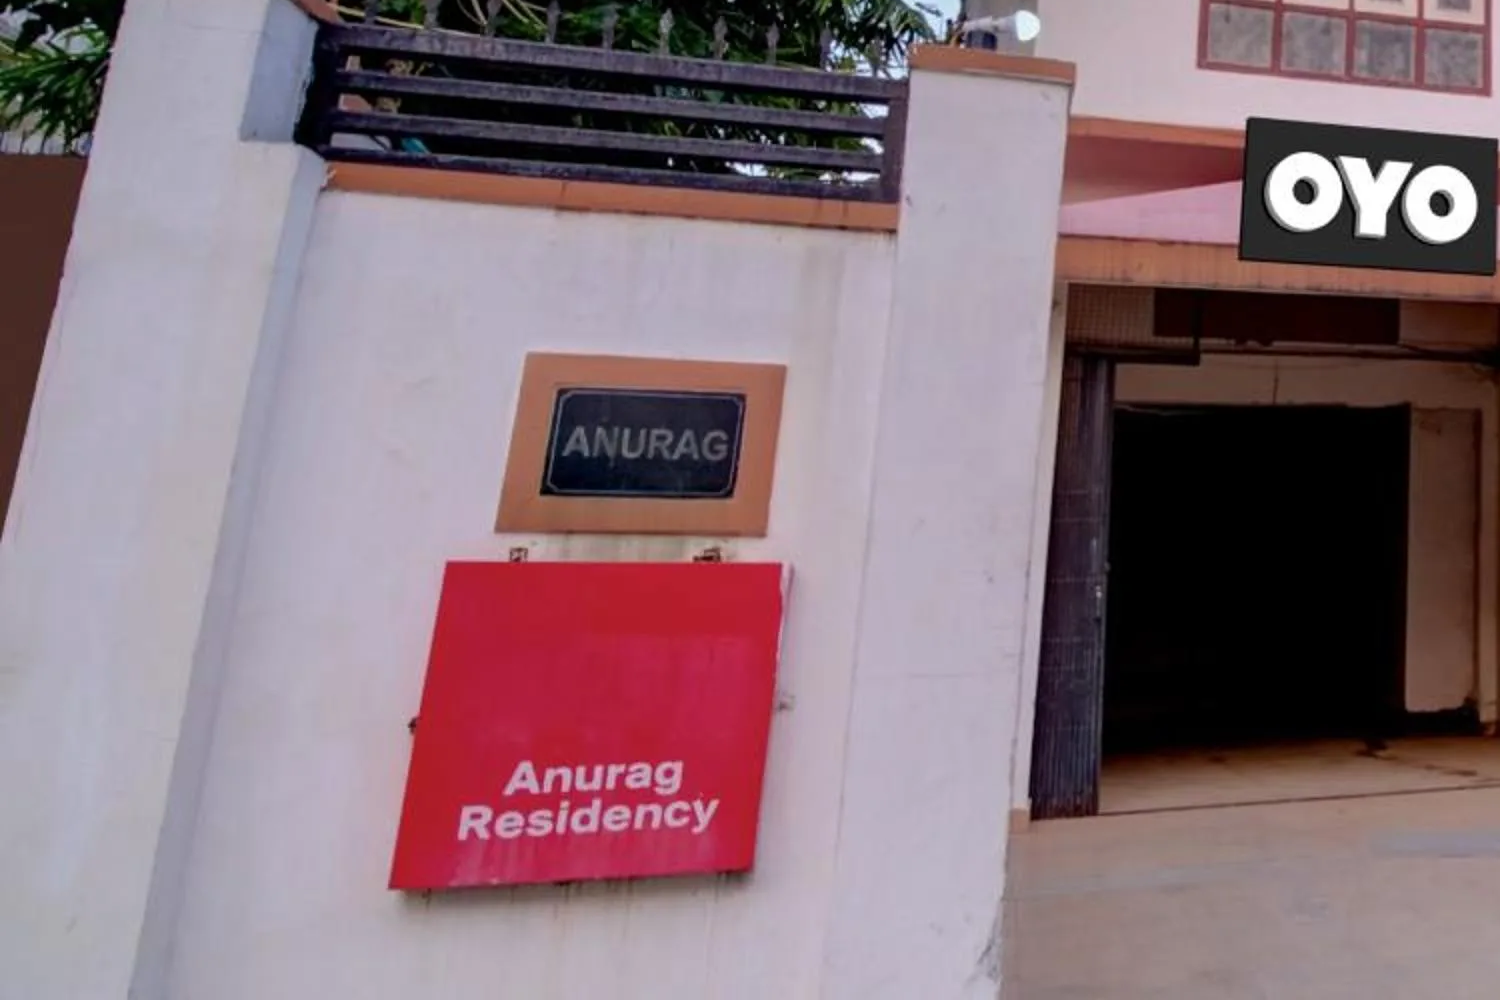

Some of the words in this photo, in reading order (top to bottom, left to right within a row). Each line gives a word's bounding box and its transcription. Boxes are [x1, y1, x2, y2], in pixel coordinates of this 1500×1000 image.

[1264, 151, 1478, 245] OYO
[562, 425, 729, 461] ANURAG
[503, 760, 684, 796] Anurag
[457, 796, 720, 841] Residency
